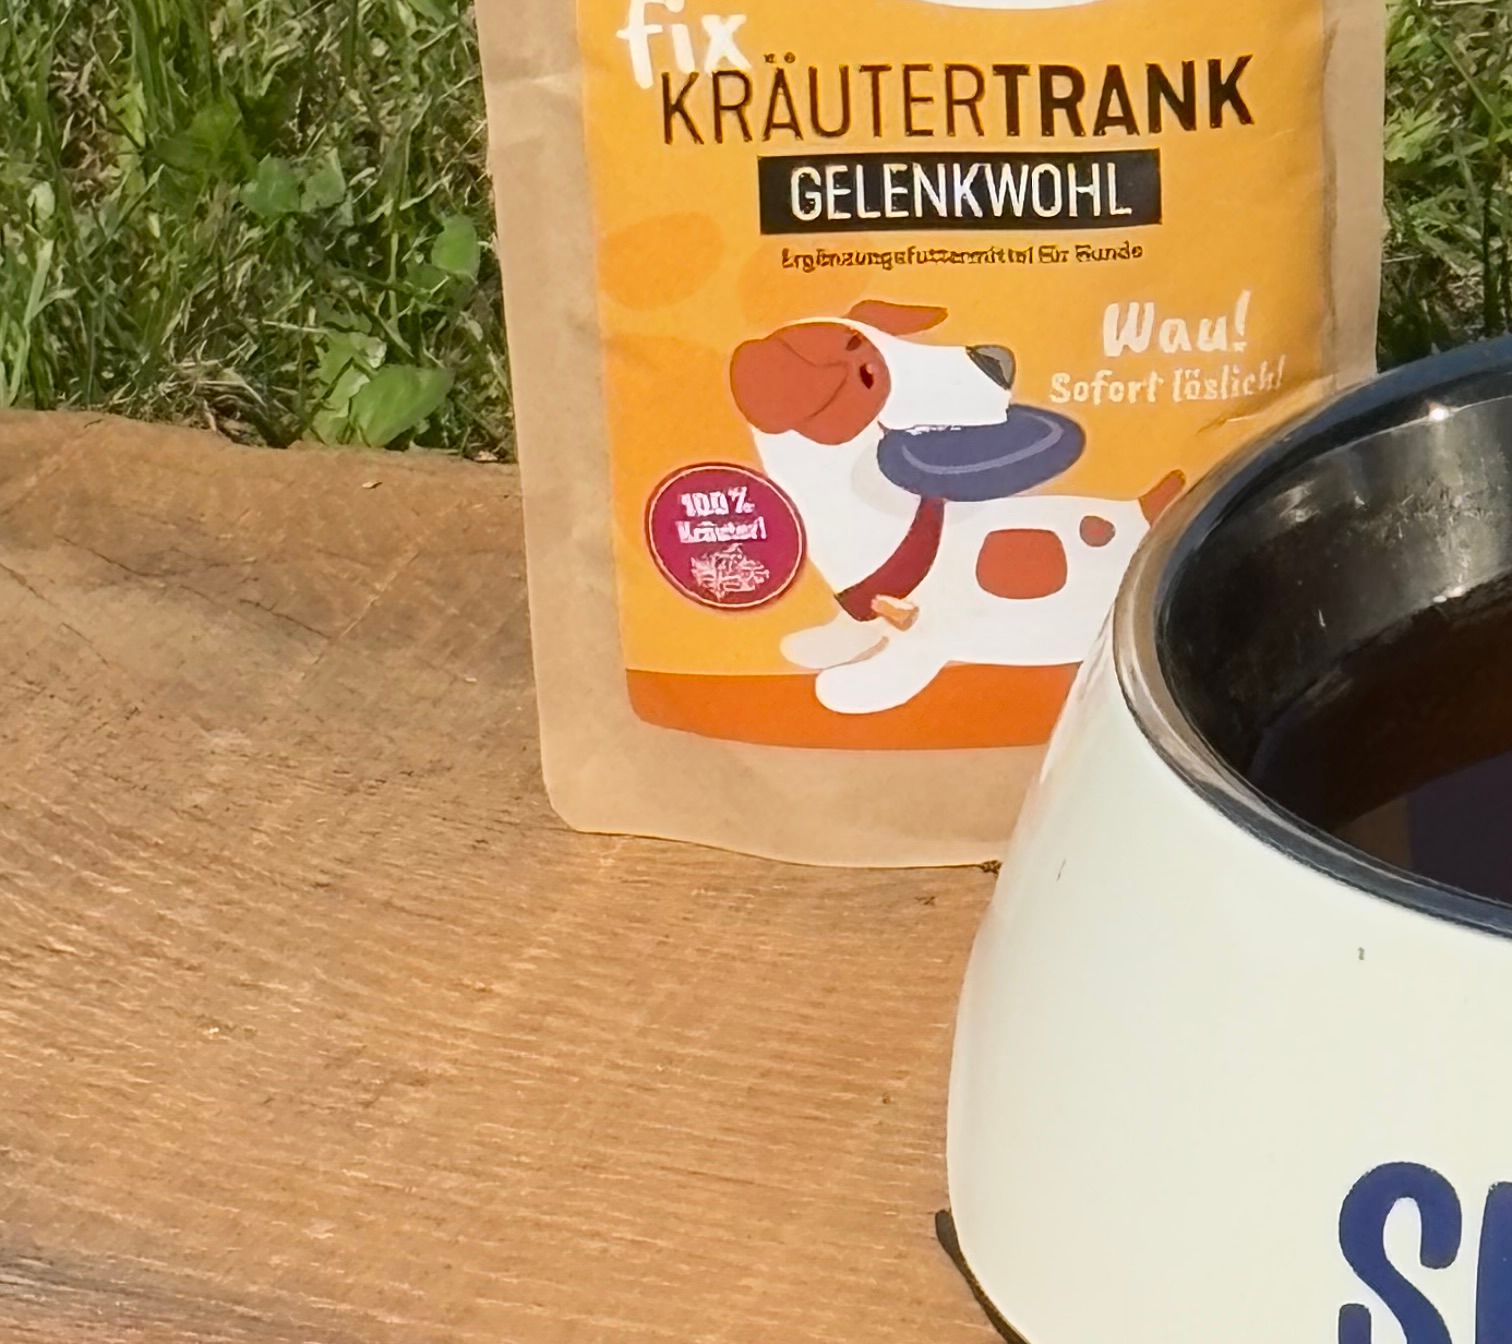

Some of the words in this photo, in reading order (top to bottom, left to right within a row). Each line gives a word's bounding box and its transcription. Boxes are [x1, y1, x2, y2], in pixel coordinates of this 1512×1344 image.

[660, 51, 1255, 145] KRÄUTERTRANK
[789, 160, 1134, 223] GELENKWOHL
[1102, 289, 1251, 358] Wau!
[1049, 369, 1164, 406] Sofort
[1172, 355, 1286, 403] löslich!
